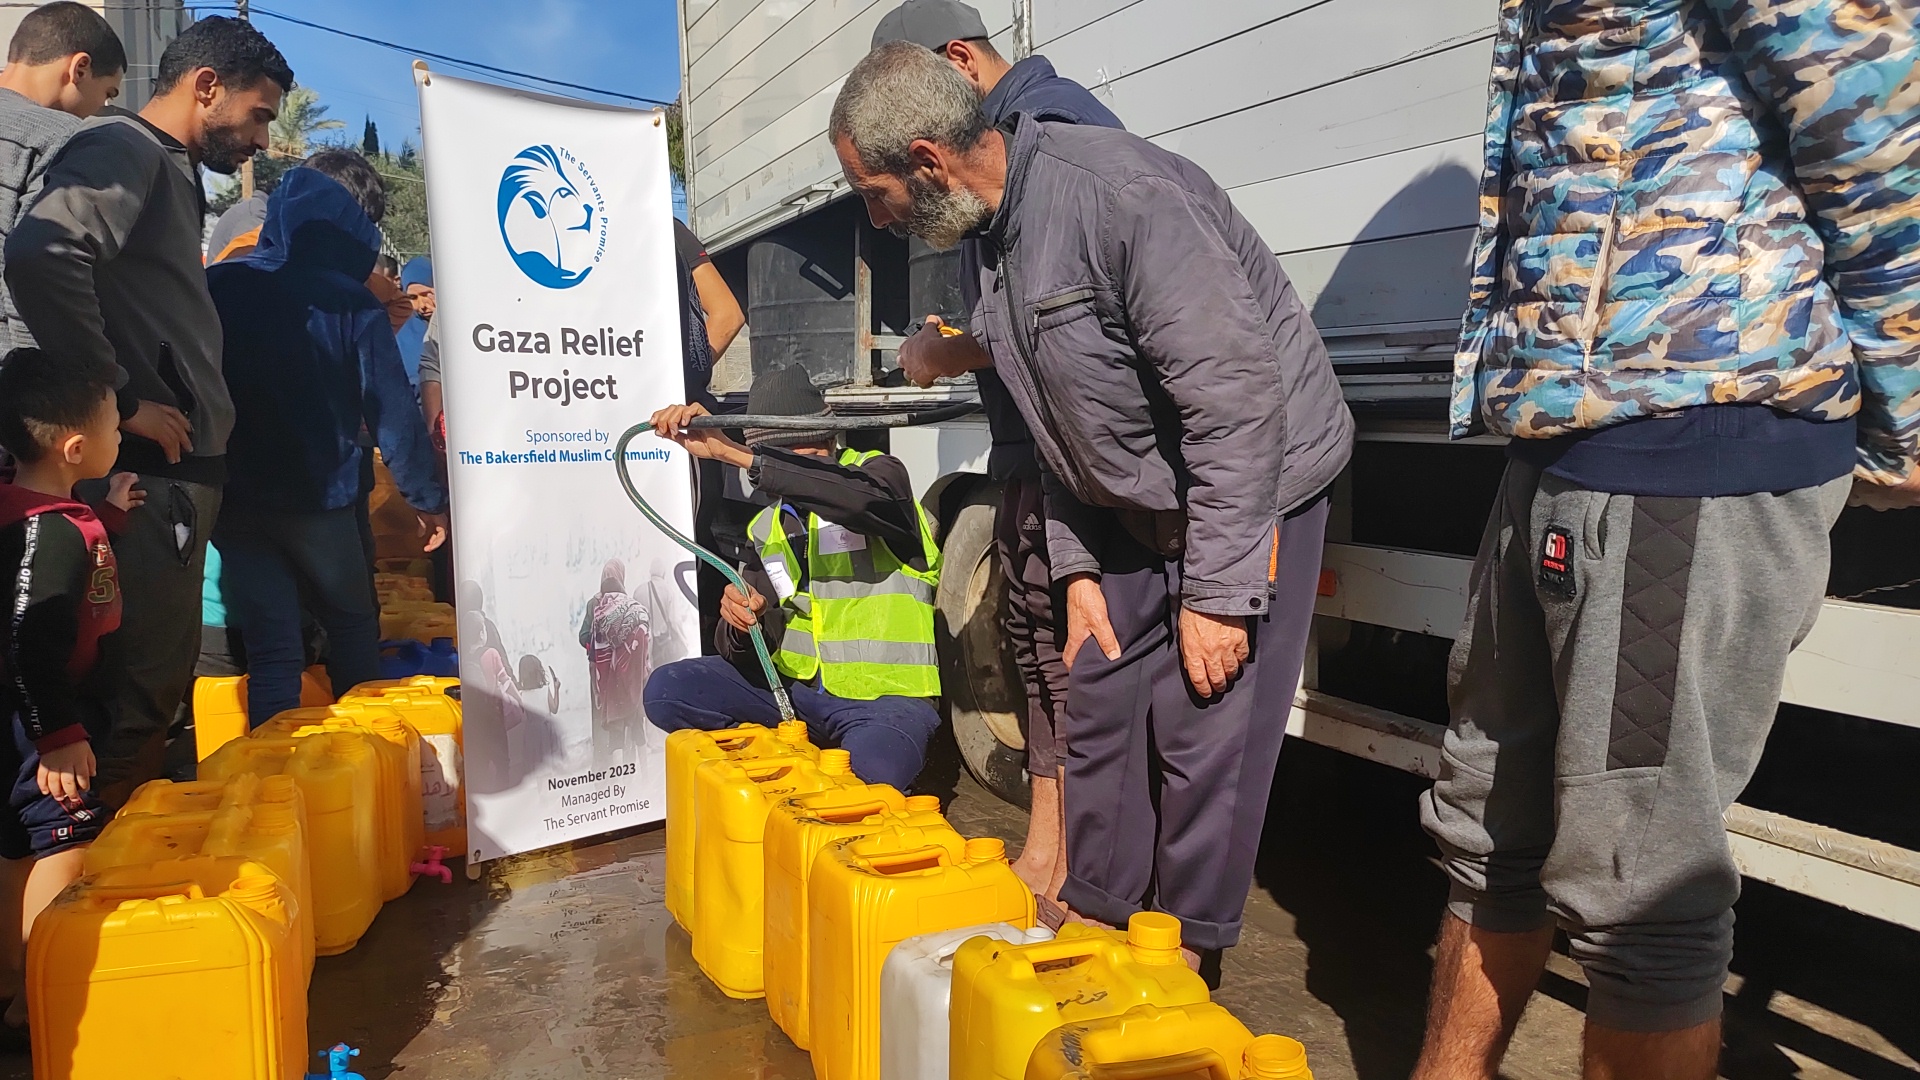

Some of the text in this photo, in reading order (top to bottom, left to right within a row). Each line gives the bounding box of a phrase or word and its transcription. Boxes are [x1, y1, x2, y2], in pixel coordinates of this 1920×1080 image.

[559, 146, 609, 263] The Servants Promise
[472, 323, 644, 357] Gaza Relief
[509, 369, 619, 407] Project
[526, 428, 610, 445] Sponsored by
[459, 451, 482, 465] The
[486, 449, 557, 464] Bakersfield
[559, 448, 602, 463] Muslim
[548, 763, 636, 791] November 2023
[561, 784, 626, 808] Managed By
[543, 799, 650, 832] The Servant Promise
